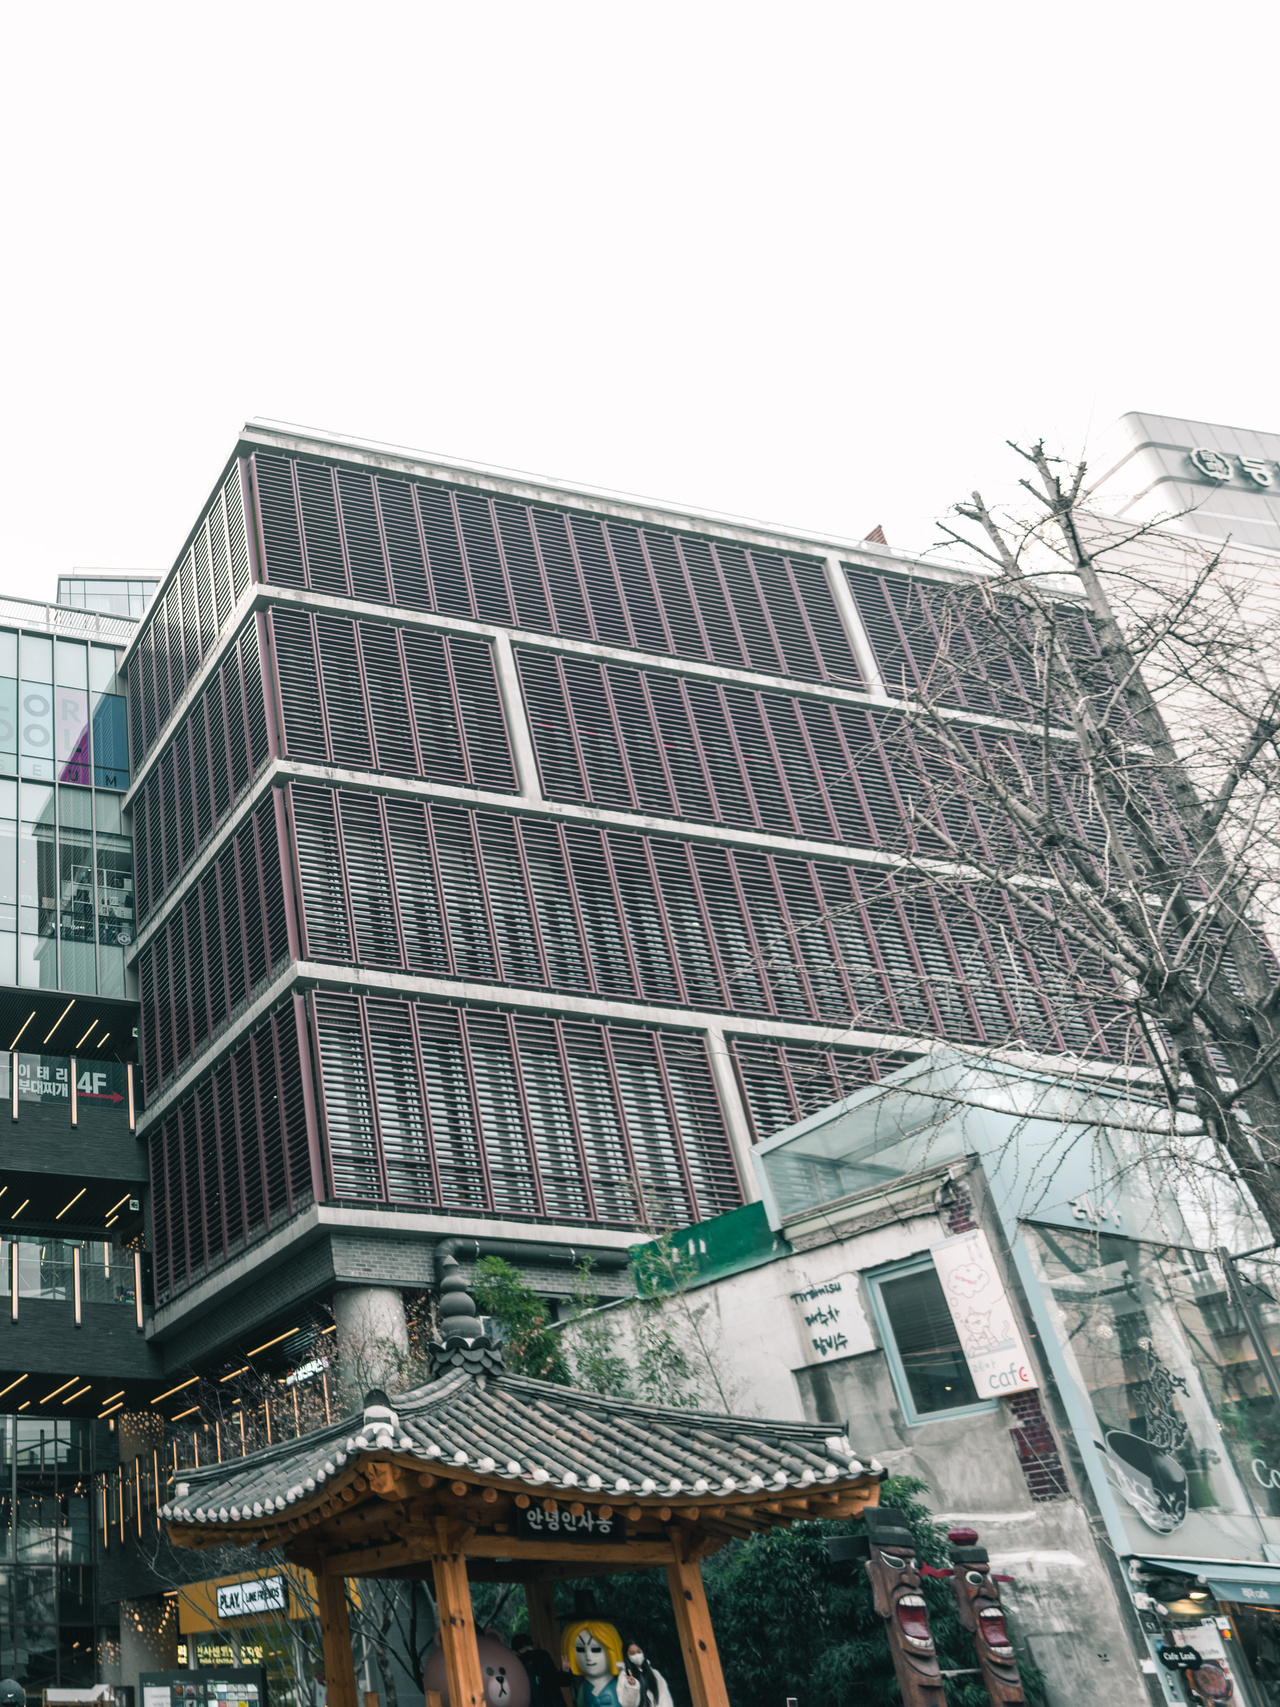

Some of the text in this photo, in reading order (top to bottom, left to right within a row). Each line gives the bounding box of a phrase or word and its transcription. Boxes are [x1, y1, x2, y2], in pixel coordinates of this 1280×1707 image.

[19, 1064, 68, 1082] 이태리
[77, 1071, 107, 1095] 4F
[19, 1079, 69, 1098] 부대찌개
[989, 1362, 1030, 1390] cafe
